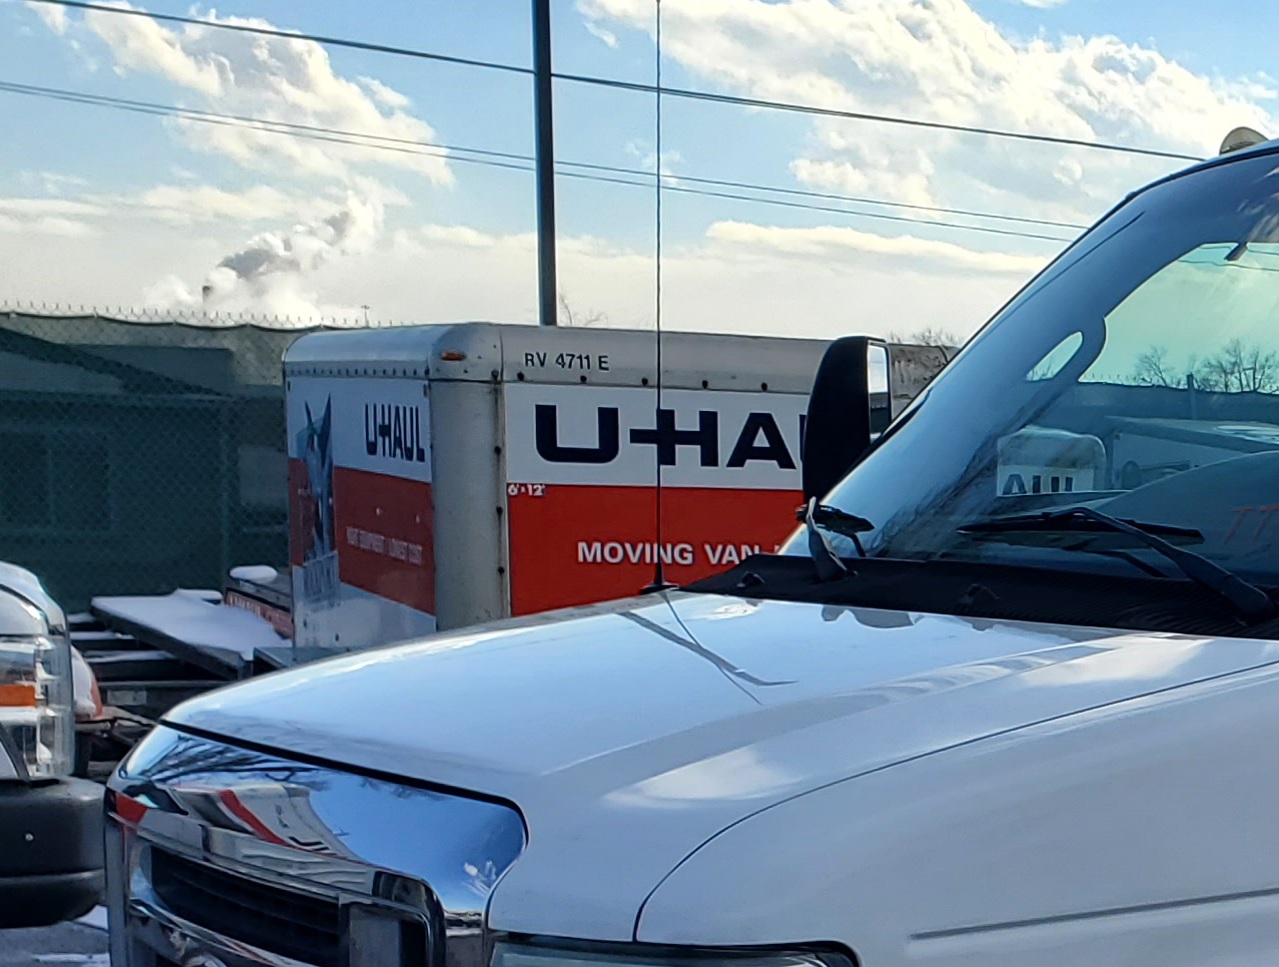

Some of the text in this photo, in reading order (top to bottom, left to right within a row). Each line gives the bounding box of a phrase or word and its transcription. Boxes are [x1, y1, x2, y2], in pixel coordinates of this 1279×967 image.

[524, 352, 610, 371] RV 4711 E
[365, 403, 425, 463] U-HAUL
[535, 404, 807, 470] U-HA
[577, 541, 694, 565] MOVING
